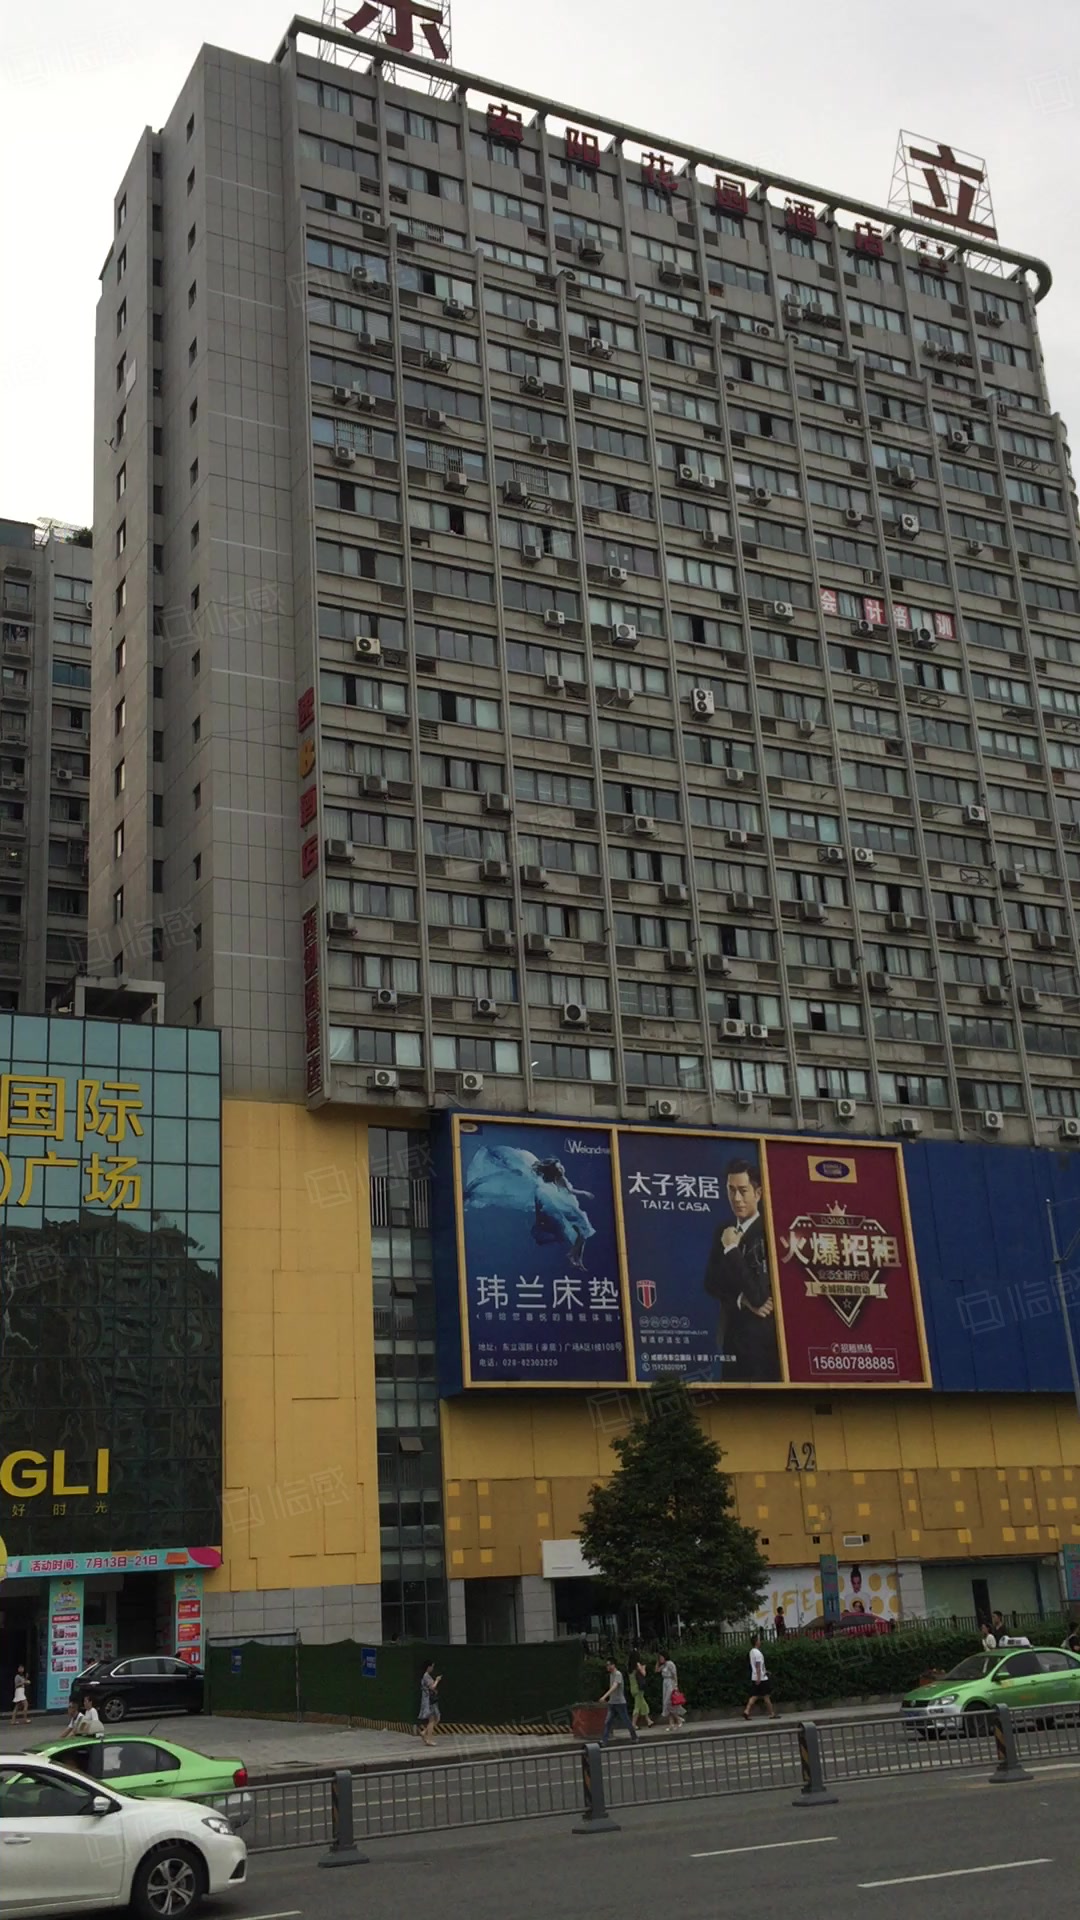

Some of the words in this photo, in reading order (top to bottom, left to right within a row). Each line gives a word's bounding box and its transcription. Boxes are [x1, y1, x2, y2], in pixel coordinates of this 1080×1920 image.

[908, 144, 998, 240] 立
[820, 590, 953, 637] 会计培训
[0, 1073, 144, 1143] 国际
[627, 1171, 720, 1200] 太子家居
[641, 1199, 675, 1211] TAIZI
[678, 1201, 711, 1213] CASA
[780, 1230, 902, 1268] 火爆招租
[476, 1274, 620, 1310] 玮兰床垫
[812, 1356, 896, 1370] 15680788885
[786, 1440, 816, 1472] A2
